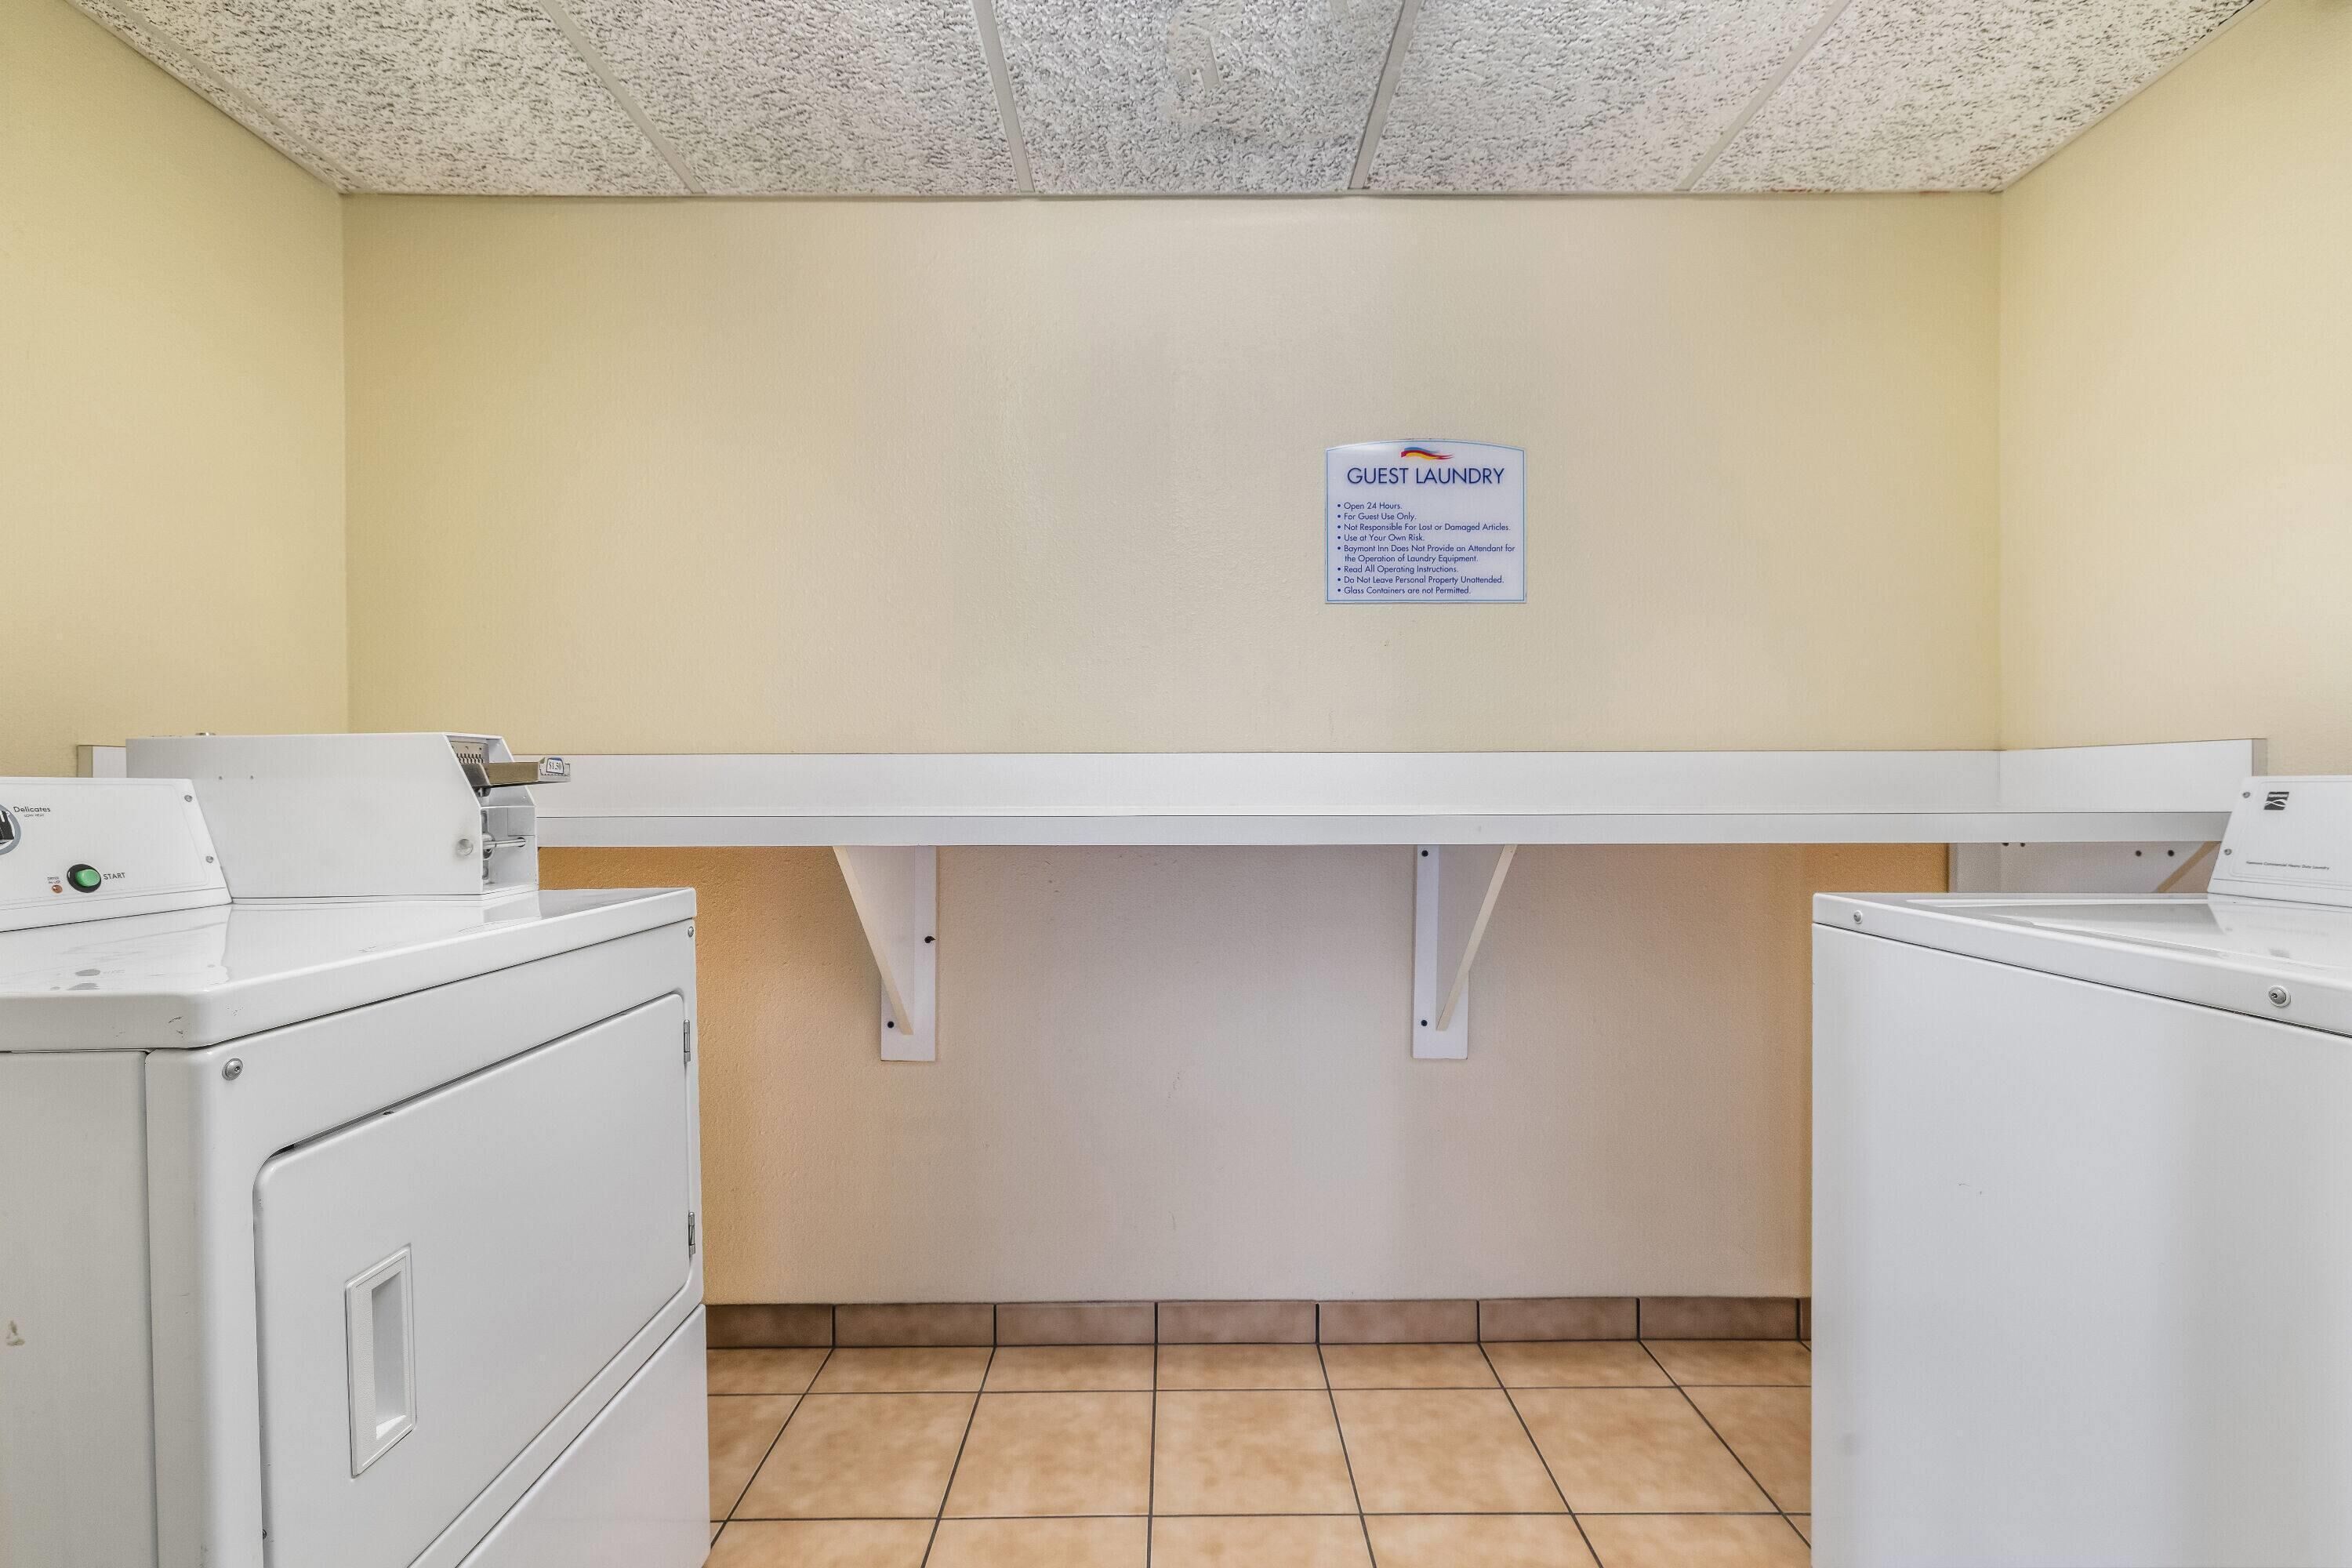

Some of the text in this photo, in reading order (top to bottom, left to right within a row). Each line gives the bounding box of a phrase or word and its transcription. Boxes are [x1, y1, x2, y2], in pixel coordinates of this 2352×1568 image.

[1348, 467, 1504, 485] GUEST LAUNDRY
[1344, 502, 1364, 511] Open
[1397, 513, 1417, 521] Only.
[1360, 522, 1402, 532] Responsible
[1445, 522, 1479, 532] Damaged
[1483, 523, 1510, 532] Articles.
[1345, 545, 1375, 554] Baymont
[1358, 555, 1395, 564] Operation
[1407, 554, 1436, 564] Laundry
[1439, 554, 1478, 564] Equipment.
[1377, 565, 1414, 575] Operating
[1428, 576, 1458, 585] Property
[549, 761, 562, 771] $1.50
